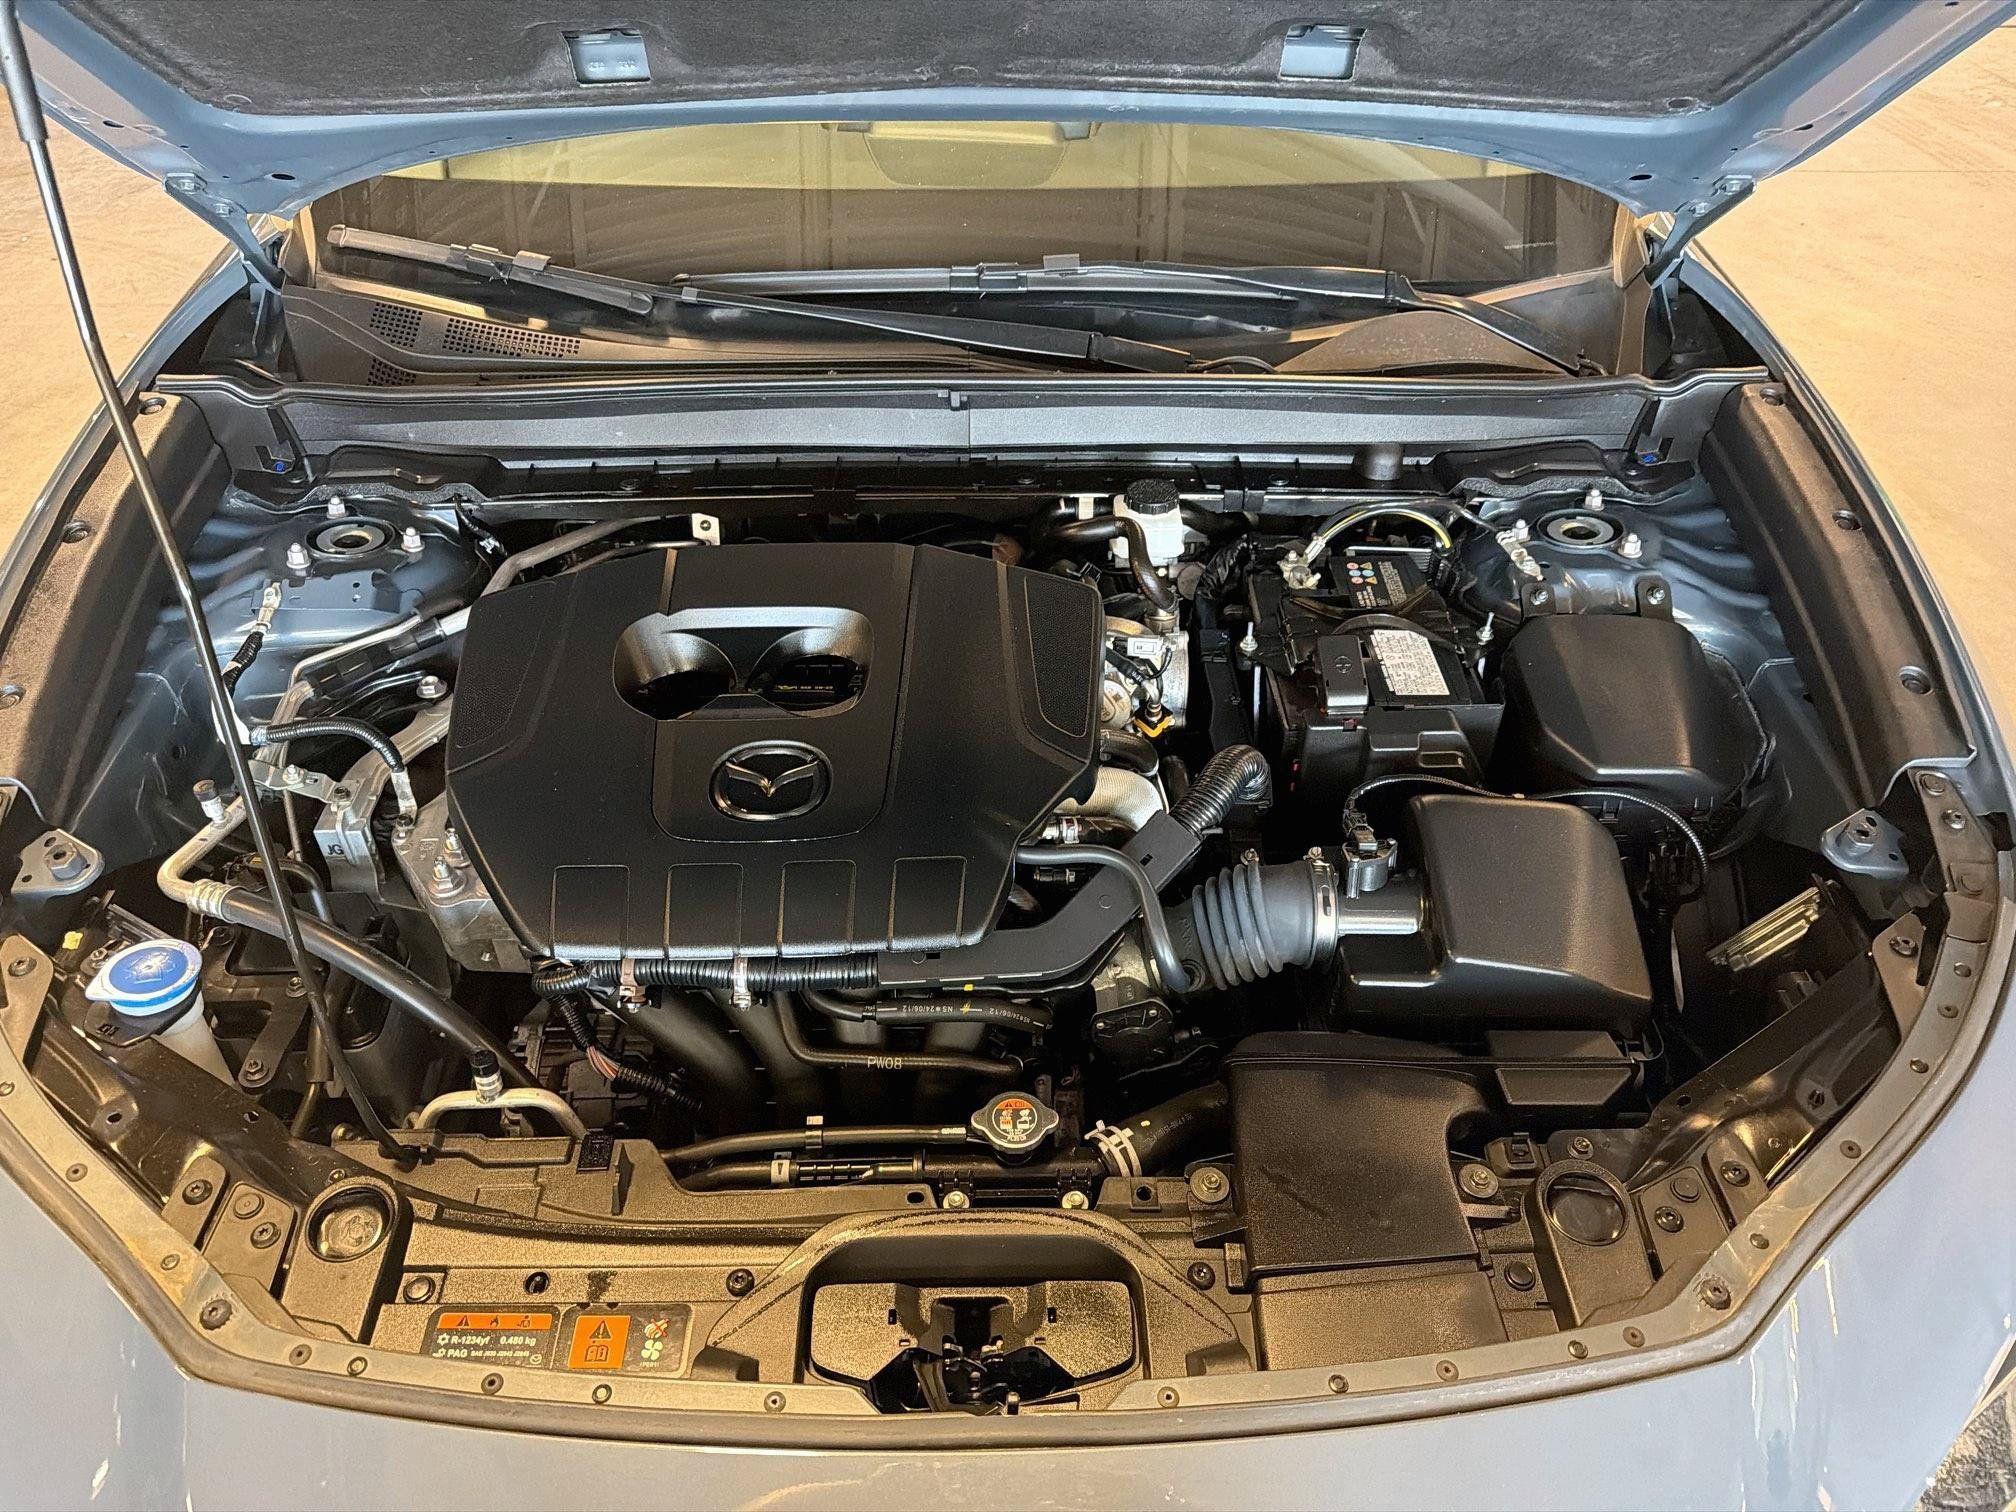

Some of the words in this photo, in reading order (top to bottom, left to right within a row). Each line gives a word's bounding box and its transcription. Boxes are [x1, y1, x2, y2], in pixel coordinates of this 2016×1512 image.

[867, 1056, 902, 1070] PW08
[524, 1337, 537, 1347] kg
[447, 1349, 468, 1358] PAG
